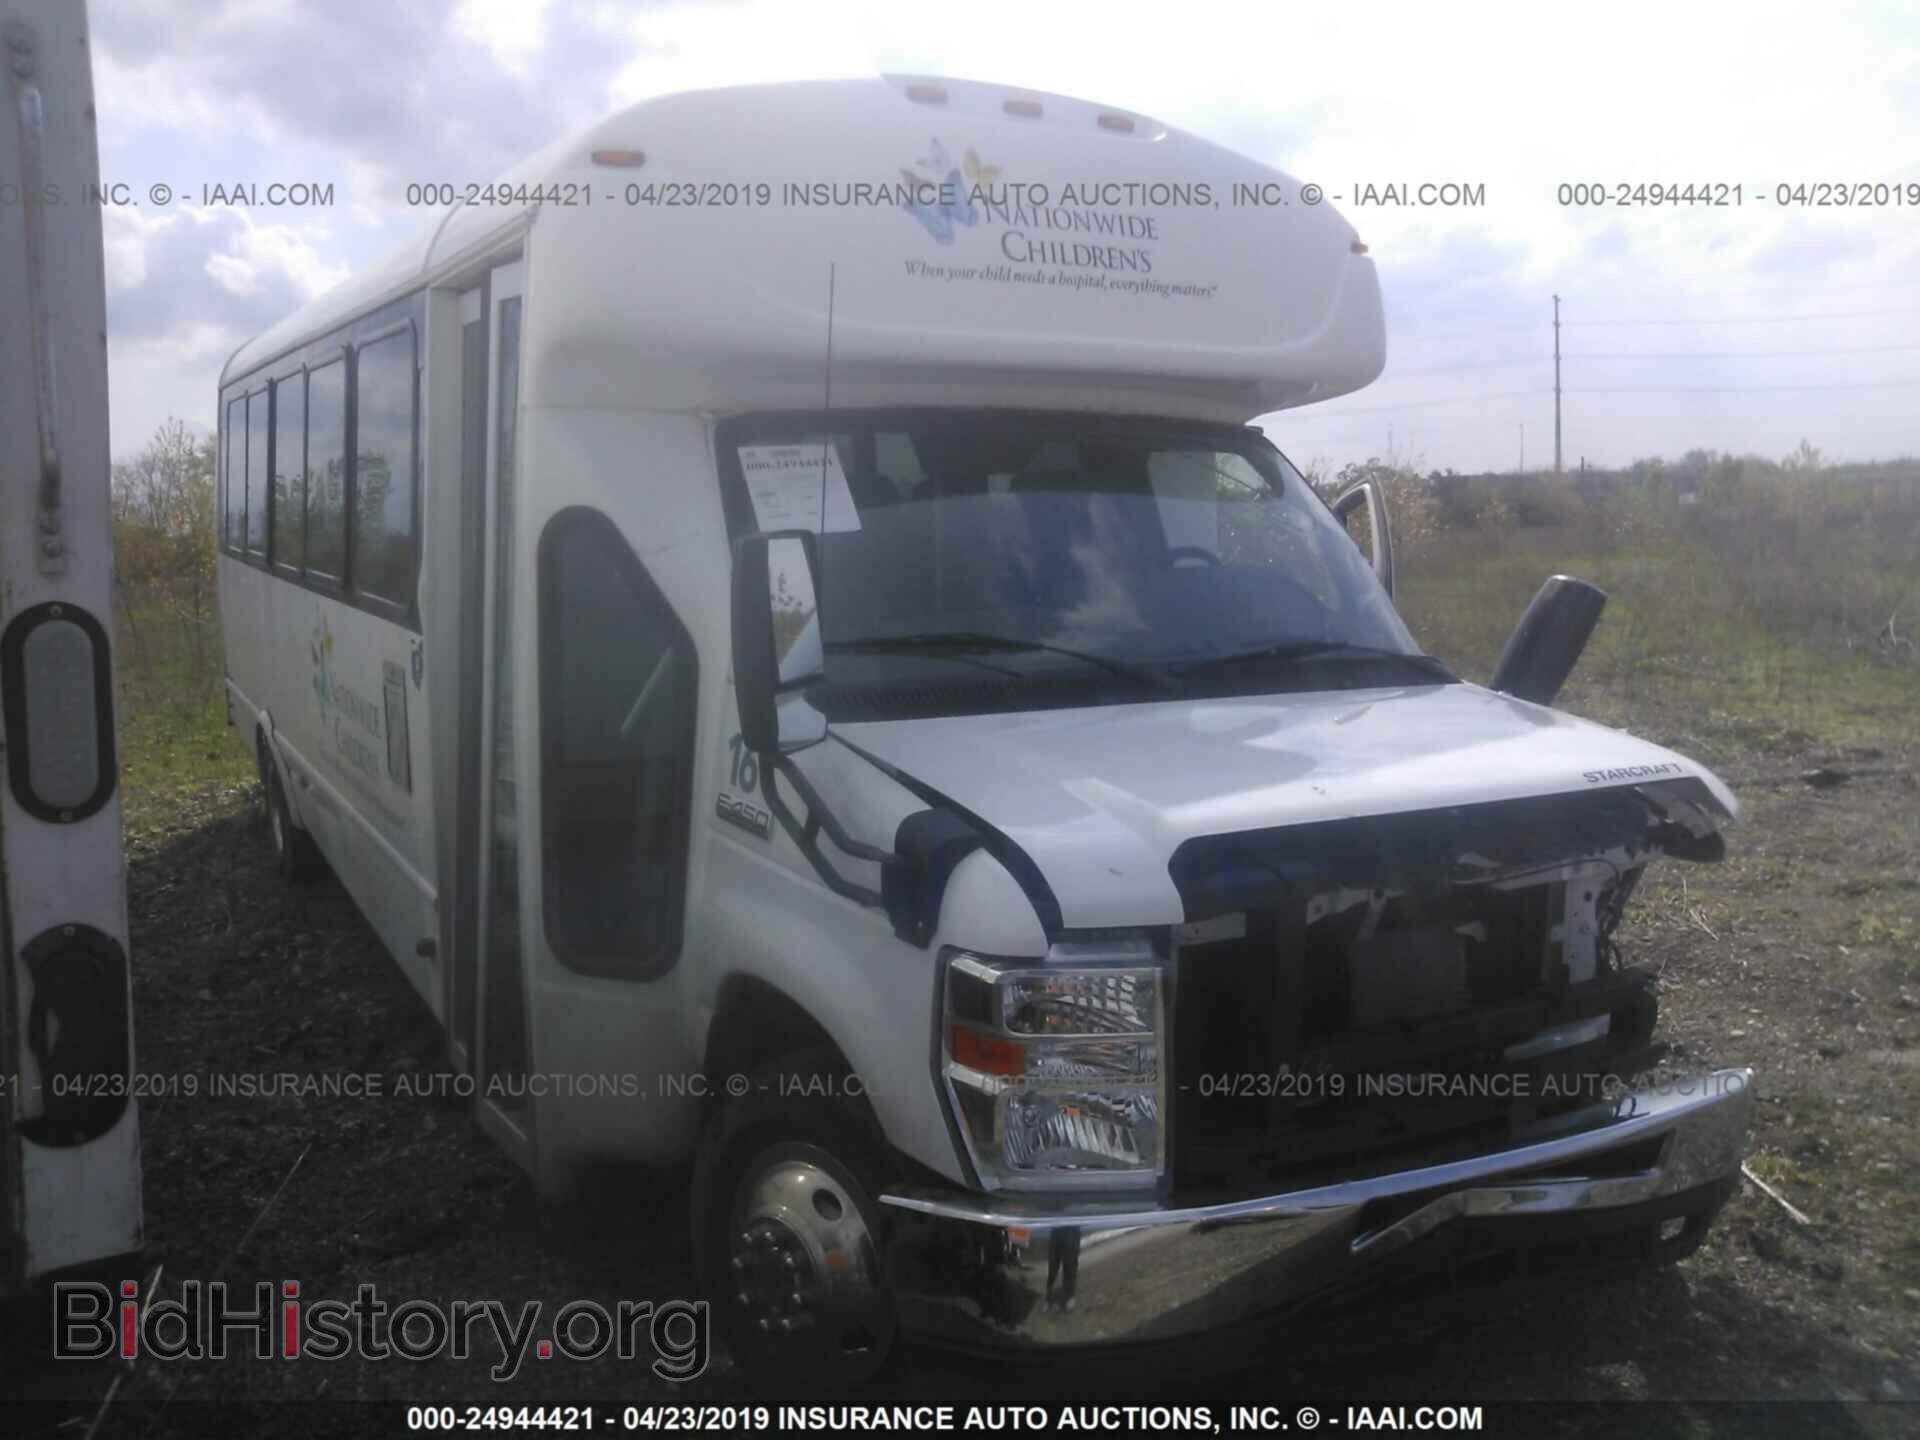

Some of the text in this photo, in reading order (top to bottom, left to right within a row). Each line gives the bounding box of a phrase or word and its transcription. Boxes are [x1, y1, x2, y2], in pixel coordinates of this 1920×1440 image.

[982, 196, 1159, 240] NATIONWIDE
[1001, 230, 1152, 273] CHILDREN'S
[904, 259, 944, 277] When
[944, 266, 978, 283] your
[979, 264, 1012, 281] child
[1014, 268, 1045, 284] needs
[1059, 270, 1107, 291] hospital,
[1109, 278, 1170, 297] everything
[1583, 762, 1683, 783] STARCRAFT
